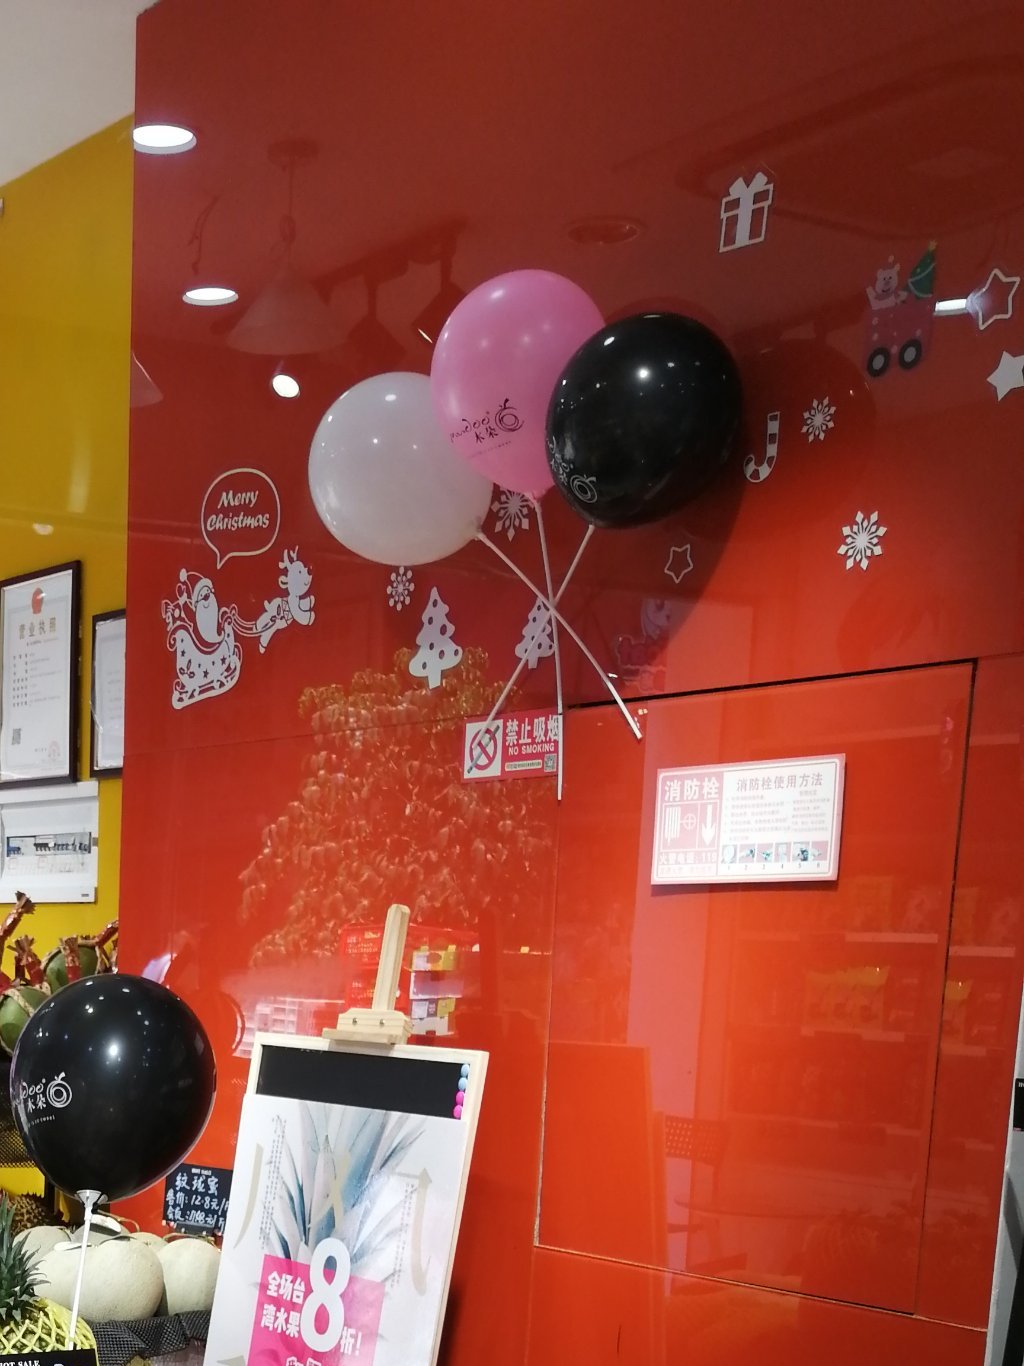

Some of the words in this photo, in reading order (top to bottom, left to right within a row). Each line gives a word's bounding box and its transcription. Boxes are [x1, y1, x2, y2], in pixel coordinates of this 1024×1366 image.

[218, 490, 258, 509] Merry
[207, 512, 270, 531] Christmas
[506, 714, 559, 746] 禁止吸烟
[509, 746, 518, 756] NO
[521, 743, 554, 755] SMOKING
[664, 777, 720, 802] 消防栓
[736, 772, 823, 793] 消防栓使用方法
[27, 1094, 47, 1113] 木朵
[266, 1271, 306, 1304] 全场台
[300, 1237, 351, 1353] 8
[260, 1303, 301, 1338] 湾水果
[340, 1326, 362, 1356] 折!
